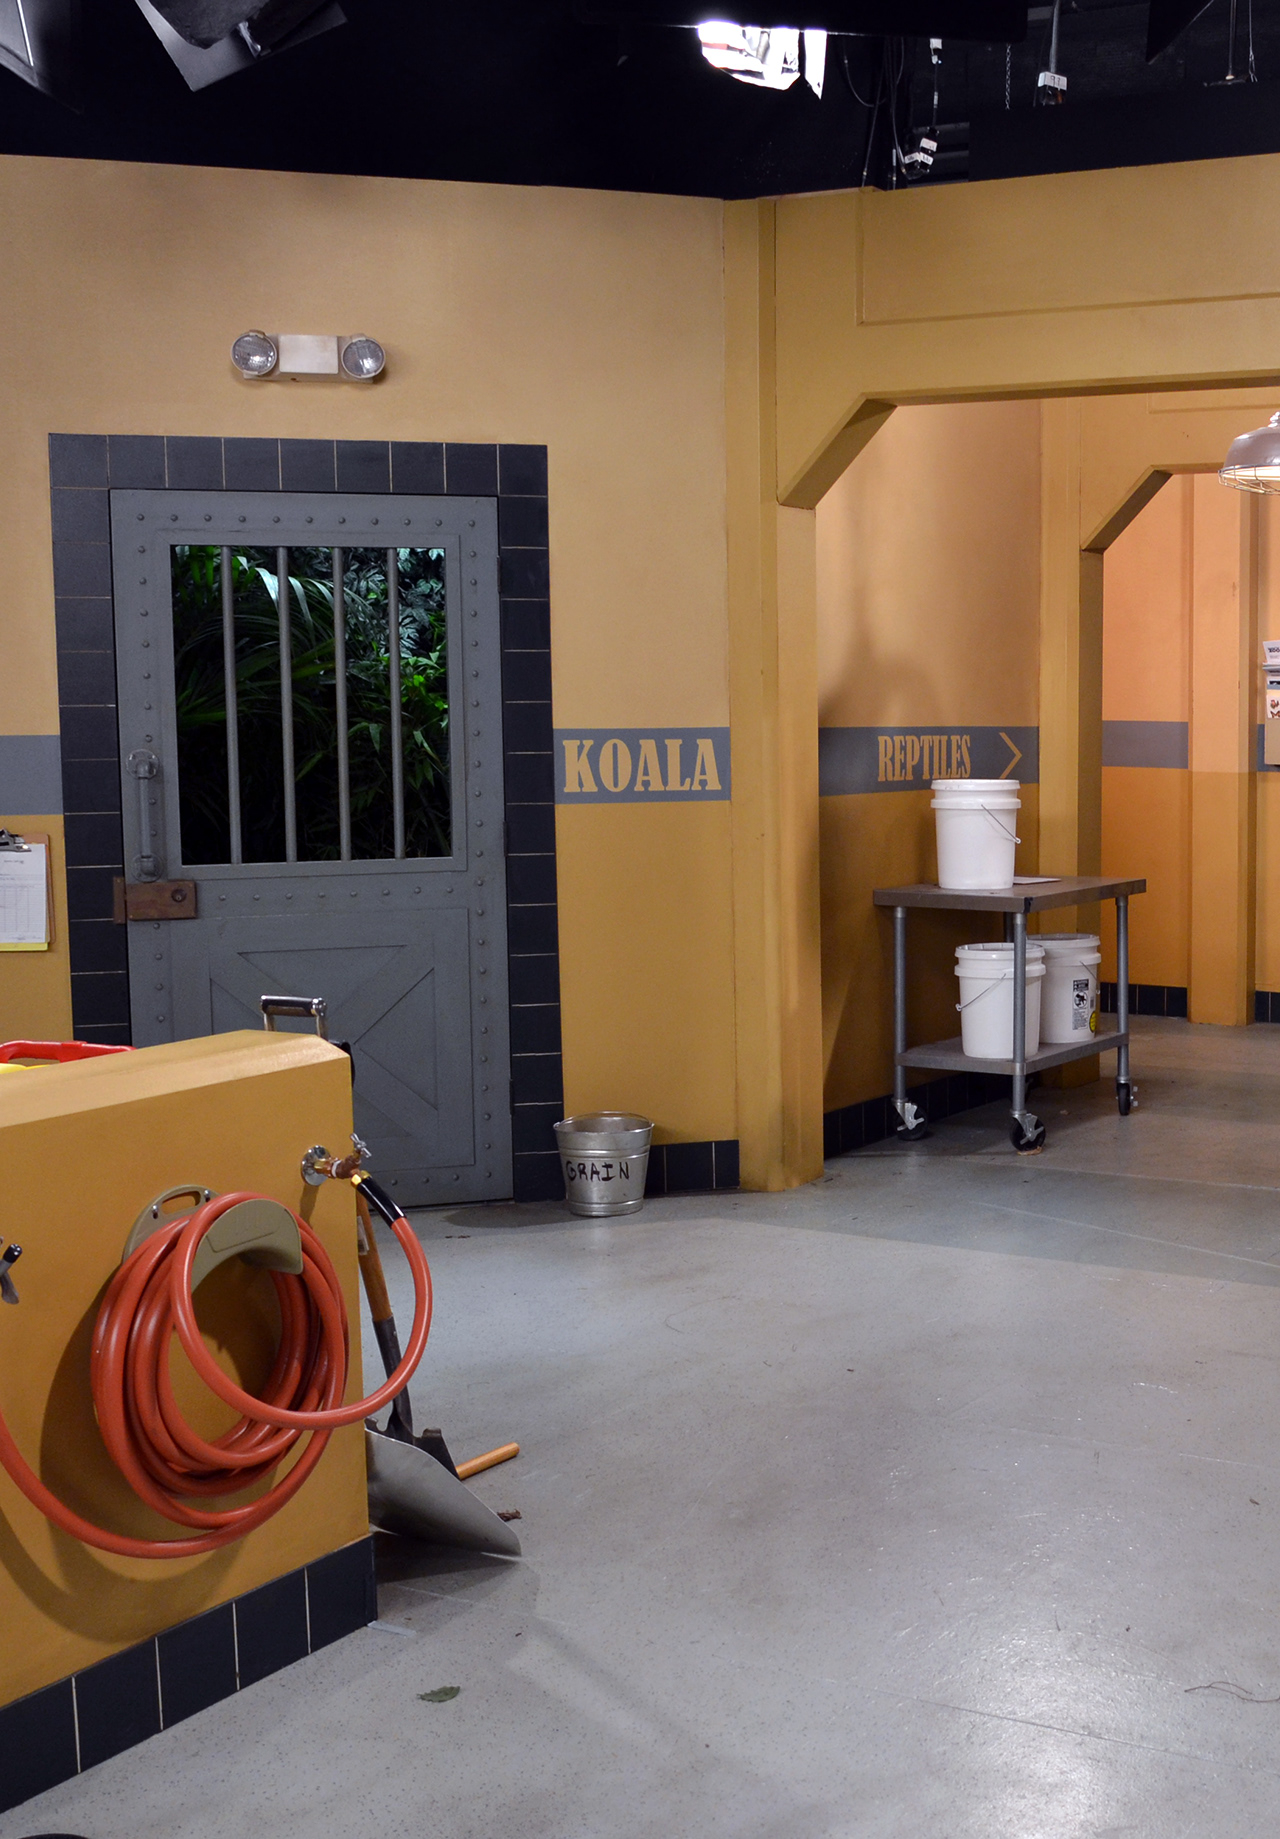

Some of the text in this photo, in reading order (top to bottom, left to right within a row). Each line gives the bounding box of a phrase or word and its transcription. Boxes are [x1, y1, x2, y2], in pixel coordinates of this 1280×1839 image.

[562, 738, 722, 792] KOALA
[877, 734, 971, 782] REPTILES
[566, 1160, 630, 1182] GRAIN
